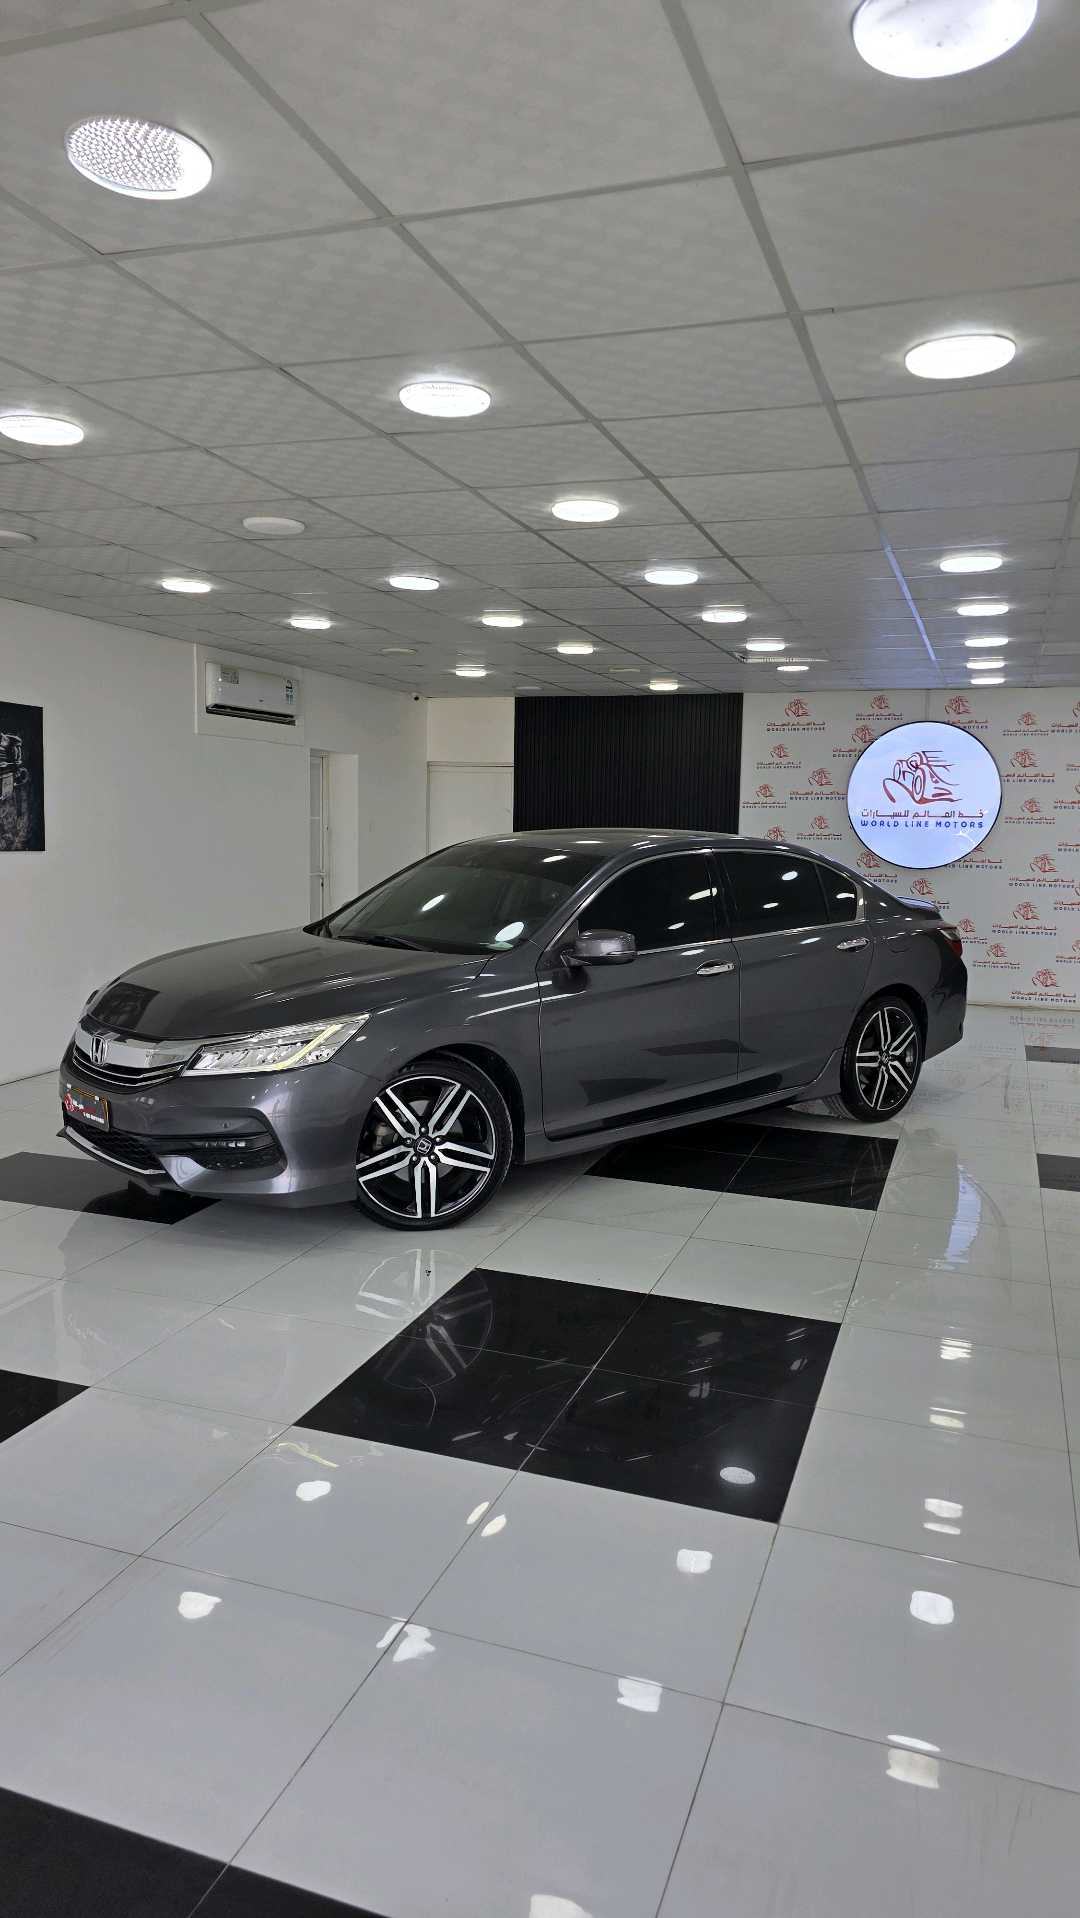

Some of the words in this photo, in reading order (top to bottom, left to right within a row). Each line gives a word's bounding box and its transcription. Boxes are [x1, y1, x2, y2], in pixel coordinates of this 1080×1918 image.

[860, 820, 900, 829] WORLD
[904, 820, 929, 829] LINE
[935, 821, 984, 829] MOTORS
